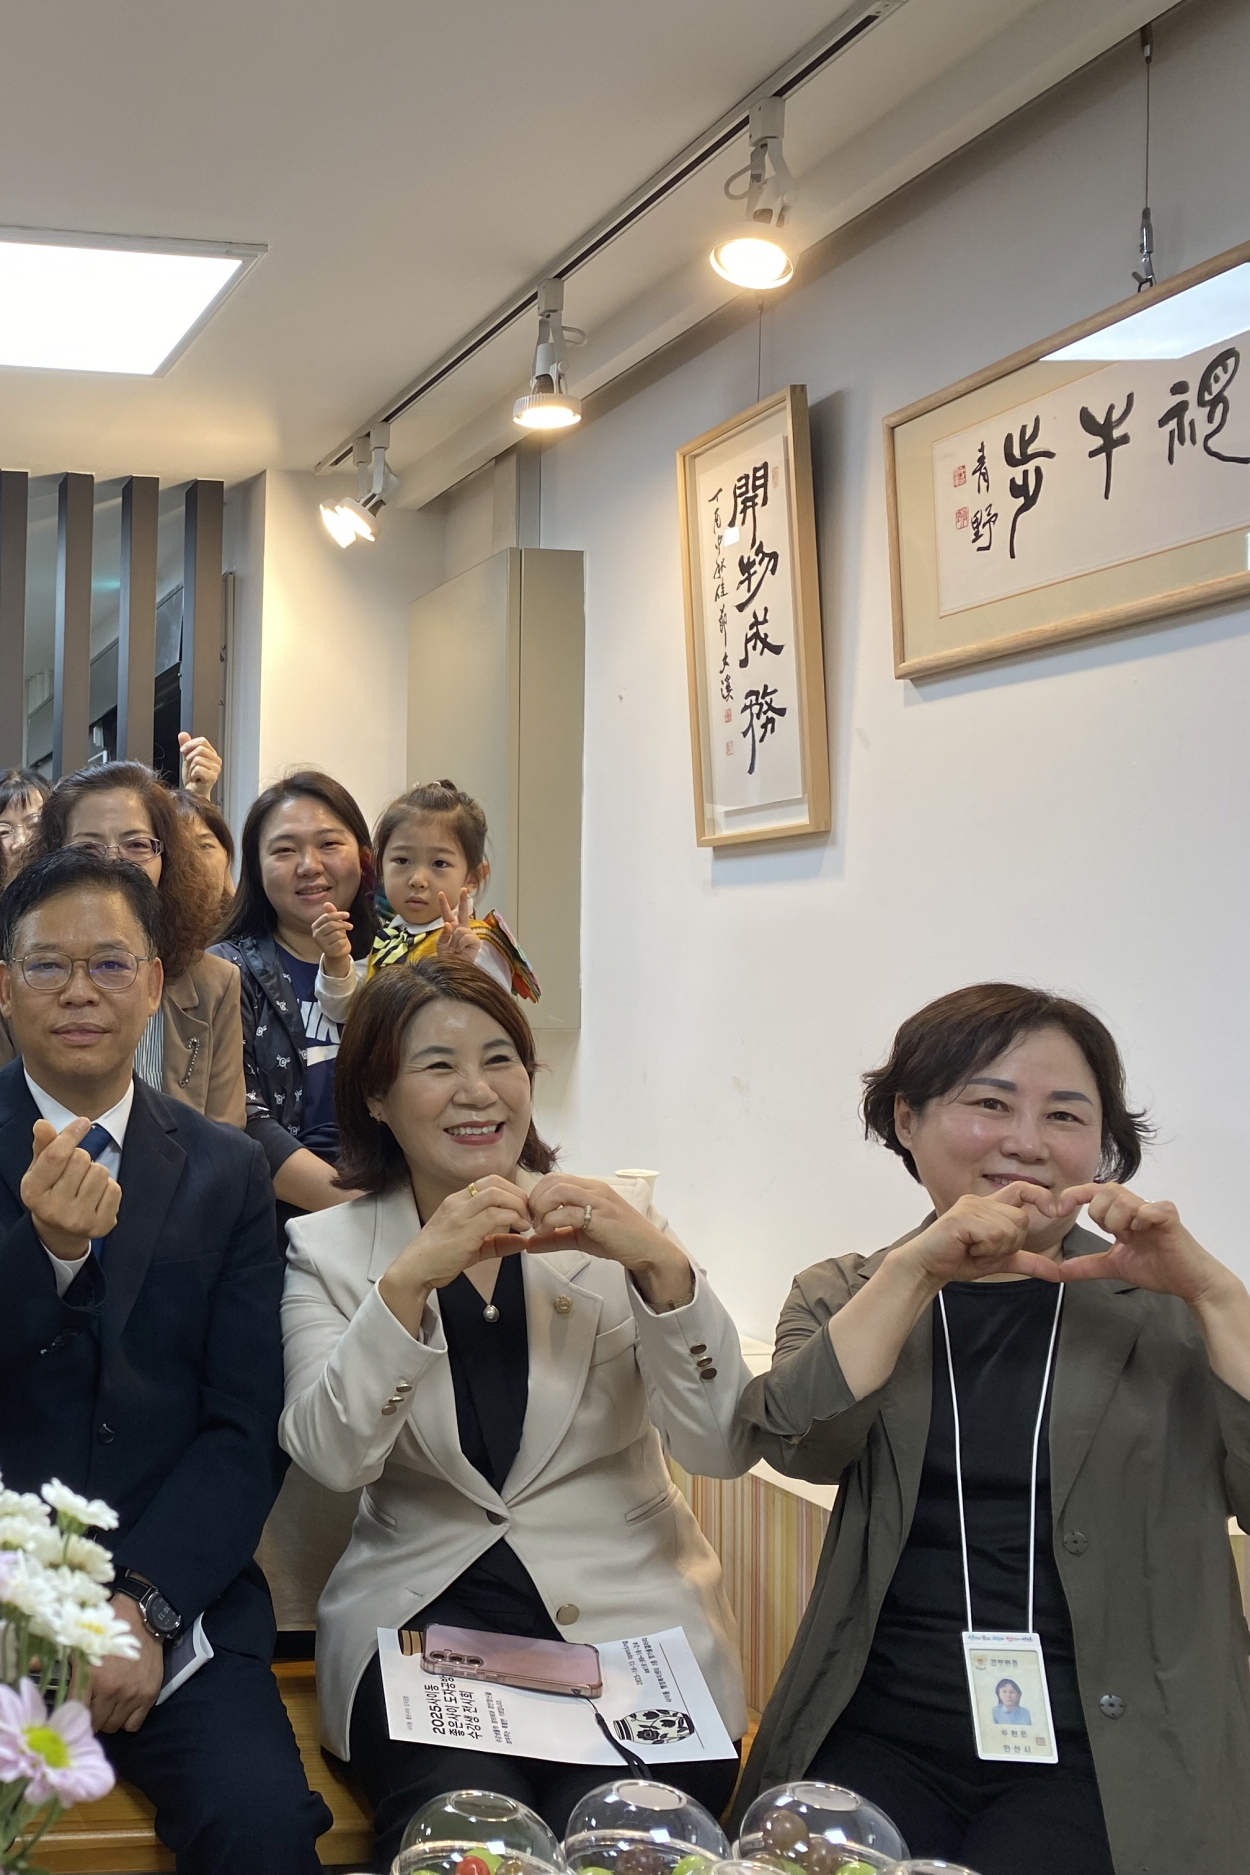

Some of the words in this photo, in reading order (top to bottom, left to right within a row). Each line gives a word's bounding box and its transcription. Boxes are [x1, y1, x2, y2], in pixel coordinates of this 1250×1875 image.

[728, 461, 787, 775] 開物成務
[439, 1675, 457, 1704] 도자공방
[458, 1690, 477, 1713] 전시회
[424, 1684, 446, 1735] 2025사이동
[445, 1705, 465, 1736] 좋은사이
[462, 1715, 483, 1739] 수강생
